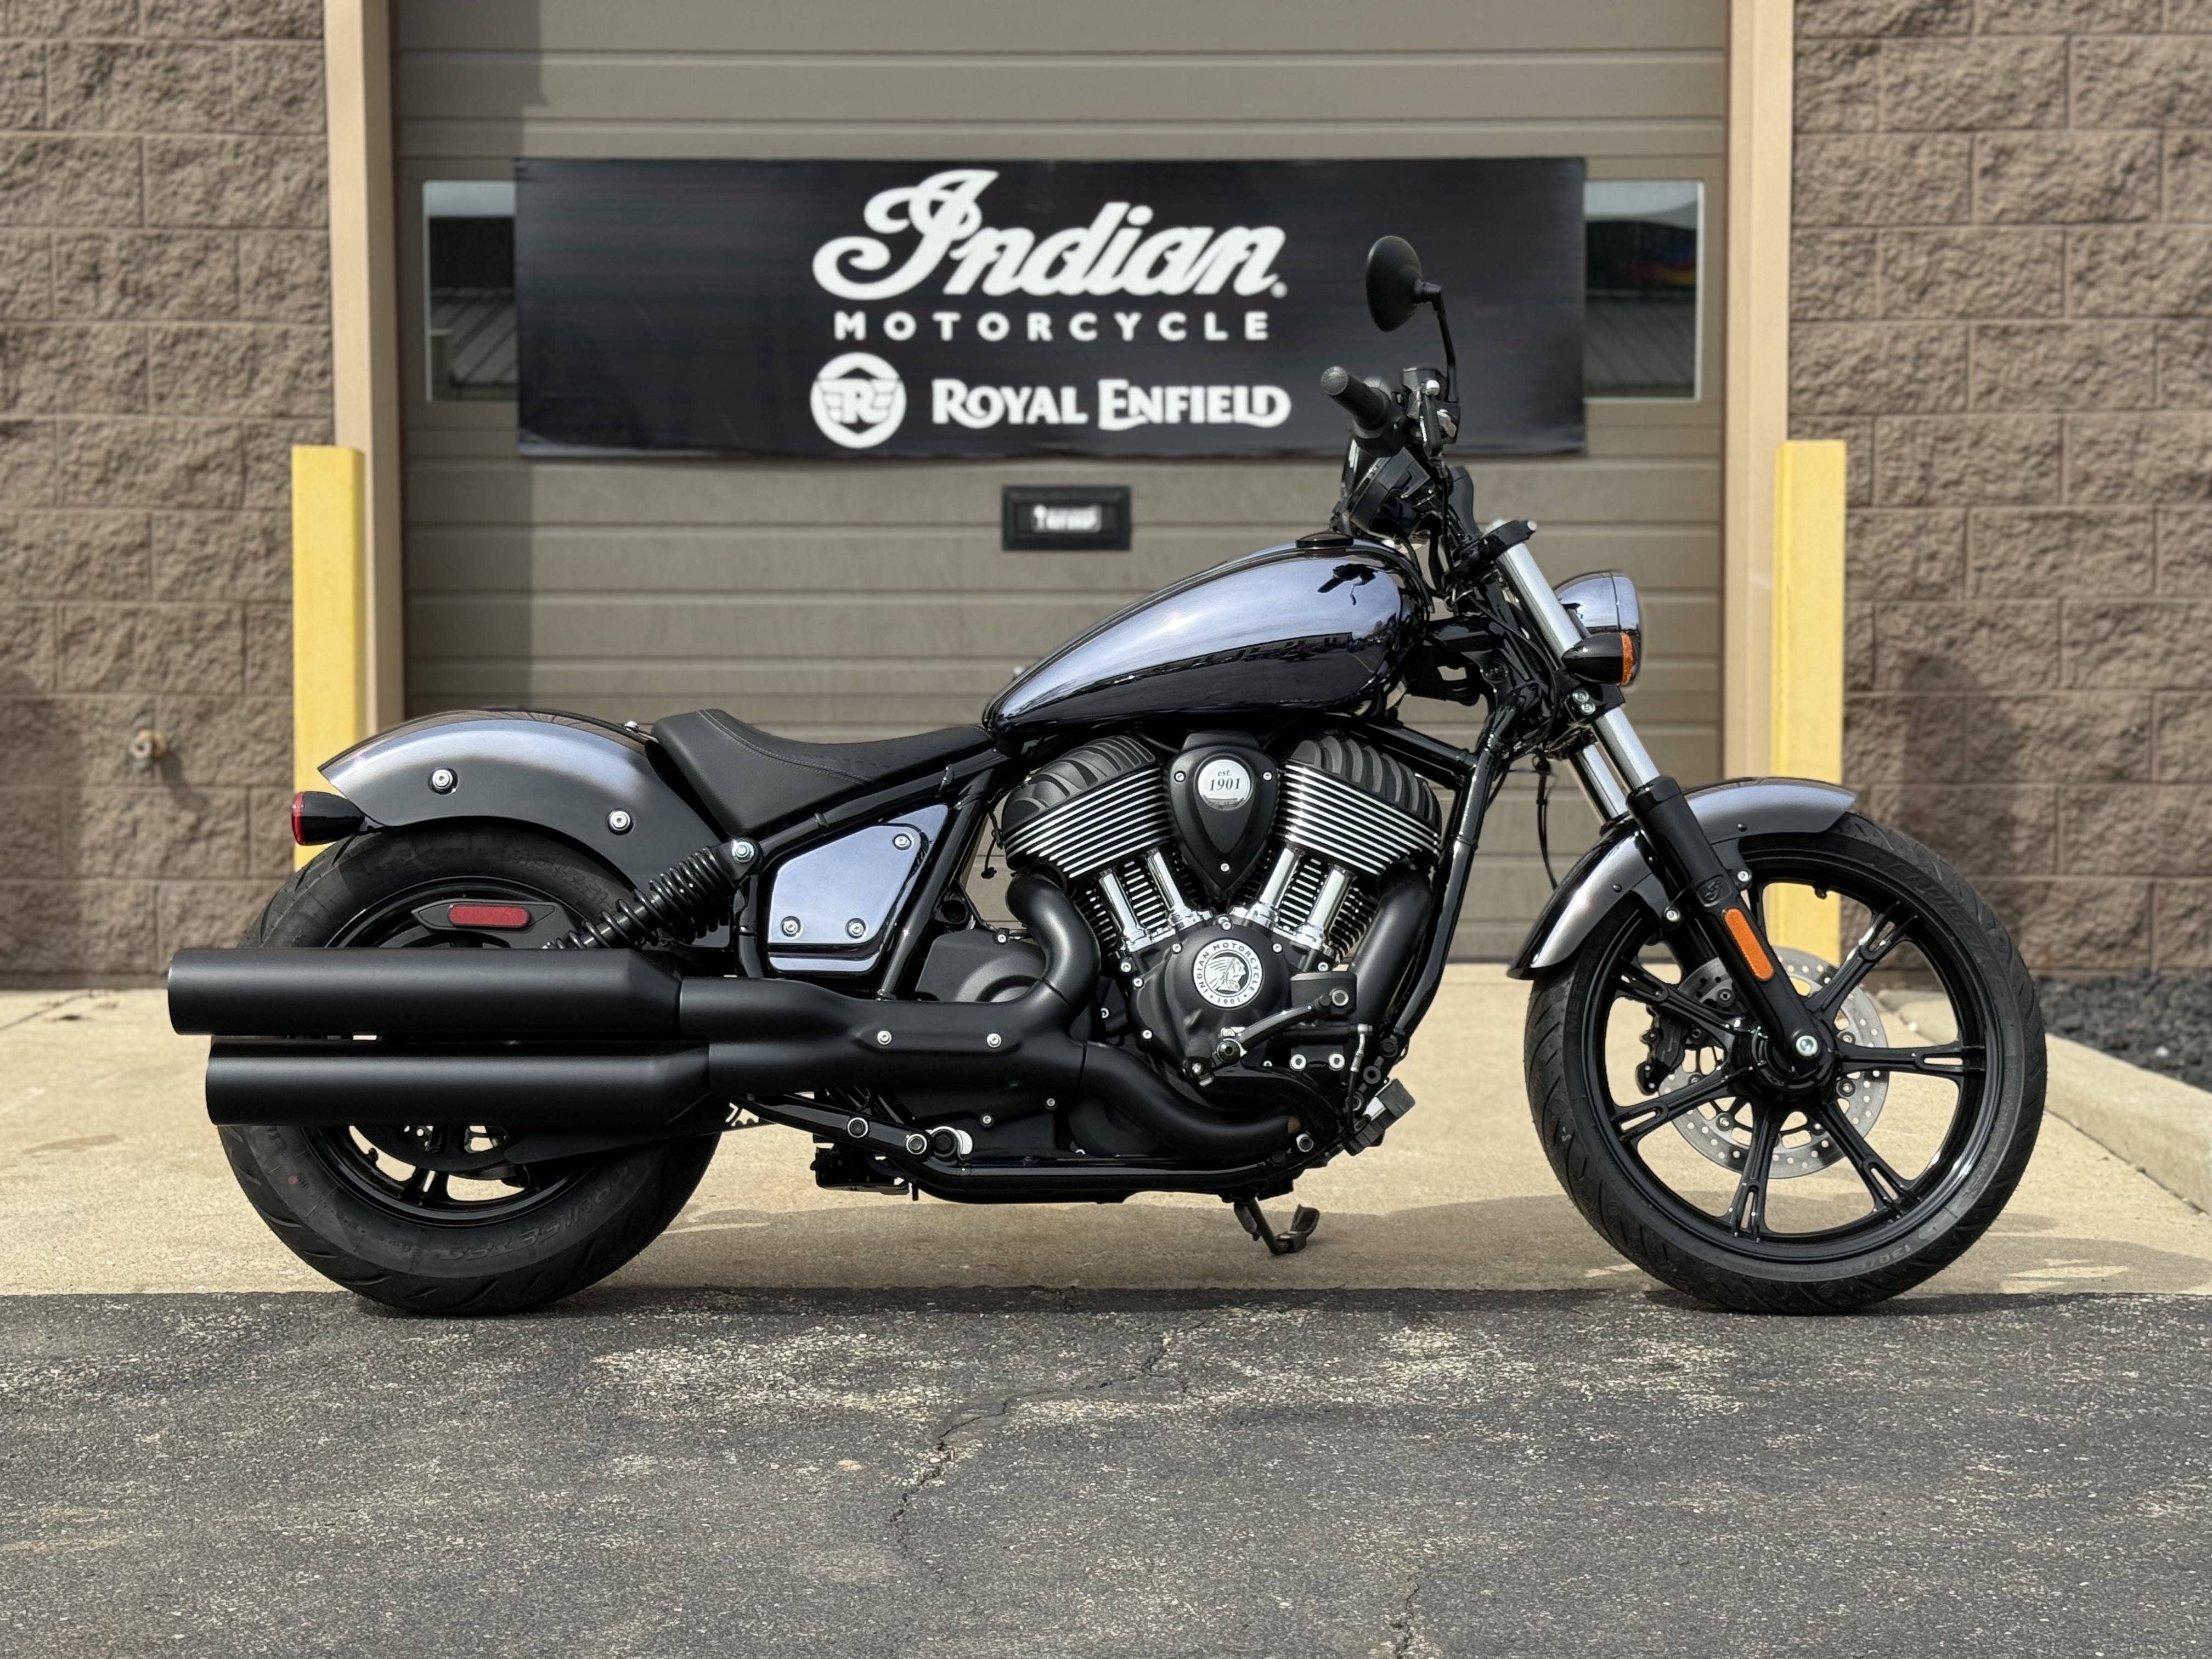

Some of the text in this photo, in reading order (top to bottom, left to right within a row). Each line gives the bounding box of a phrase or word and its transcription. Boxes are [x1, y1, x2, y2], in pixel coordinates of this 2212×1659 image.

[834, 311, 1268, 341] MOTORCYCLE
[932, 379, 1088, 429] ROYAL
[1098, 379, 1291, 431] ENFIELD
[1209, 777, 1240, 791] 1901
[1197, 942, 1260, 994] INDIAN MOTORCYCLE
